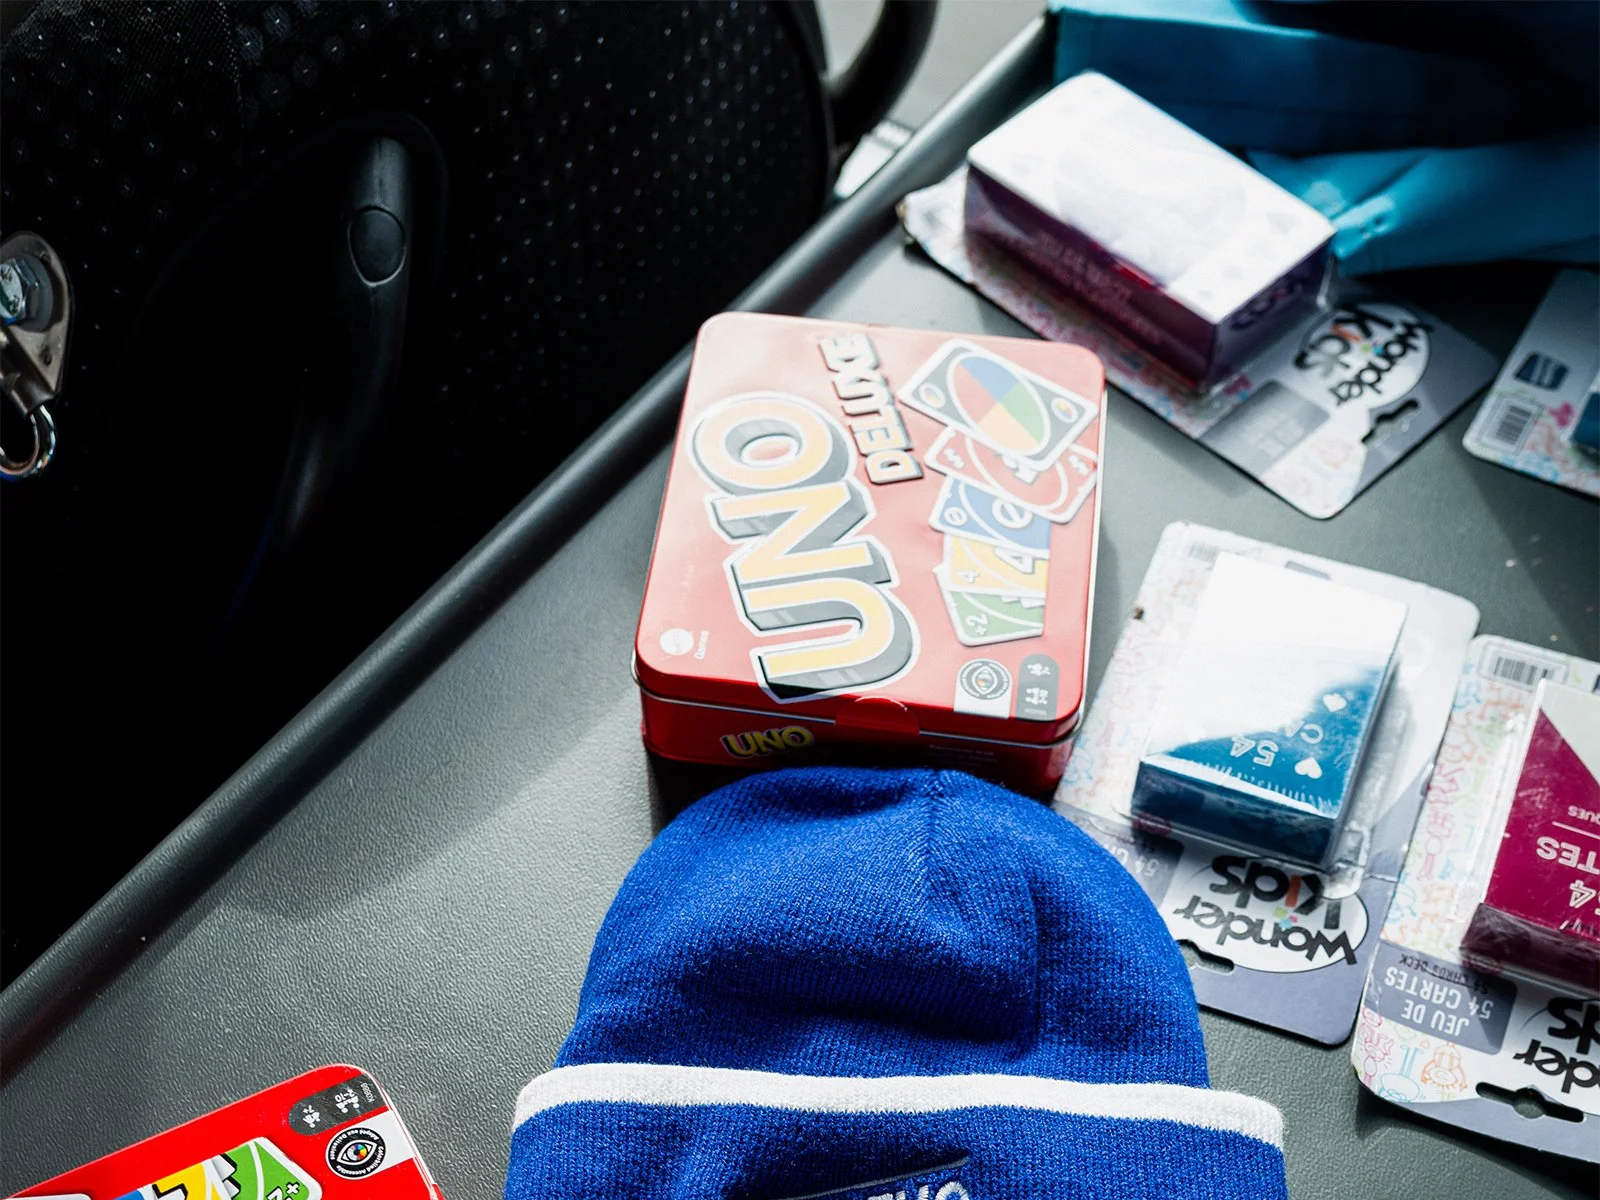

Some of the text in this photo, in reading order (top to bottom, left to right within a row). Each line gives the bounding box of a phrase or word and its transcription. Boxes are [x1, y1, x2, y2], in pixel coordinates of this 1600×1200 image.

[1328, 320, 1434, 407] Wonder
[817, 331, 924, 485] DELUXE
[686, 390, 921, 703] UNO
[721, 726, 814, 760] UNO
[1229, 736, 1279, 767] 54
[1536, 836, 1600, 875] TES
[1209, 855, 1342, 930] Kids
[1173, 895, 1357, 966] Wonder
[1399, 953, 1428, 973] DECK
[1384, 966, 1494, 1020] 54 CARTES
[1401, 1000, 1470, 1037] JEU DE
[1547, 997, 1600, 1056] ds
[1513, 1039, 1600, 1094] der
